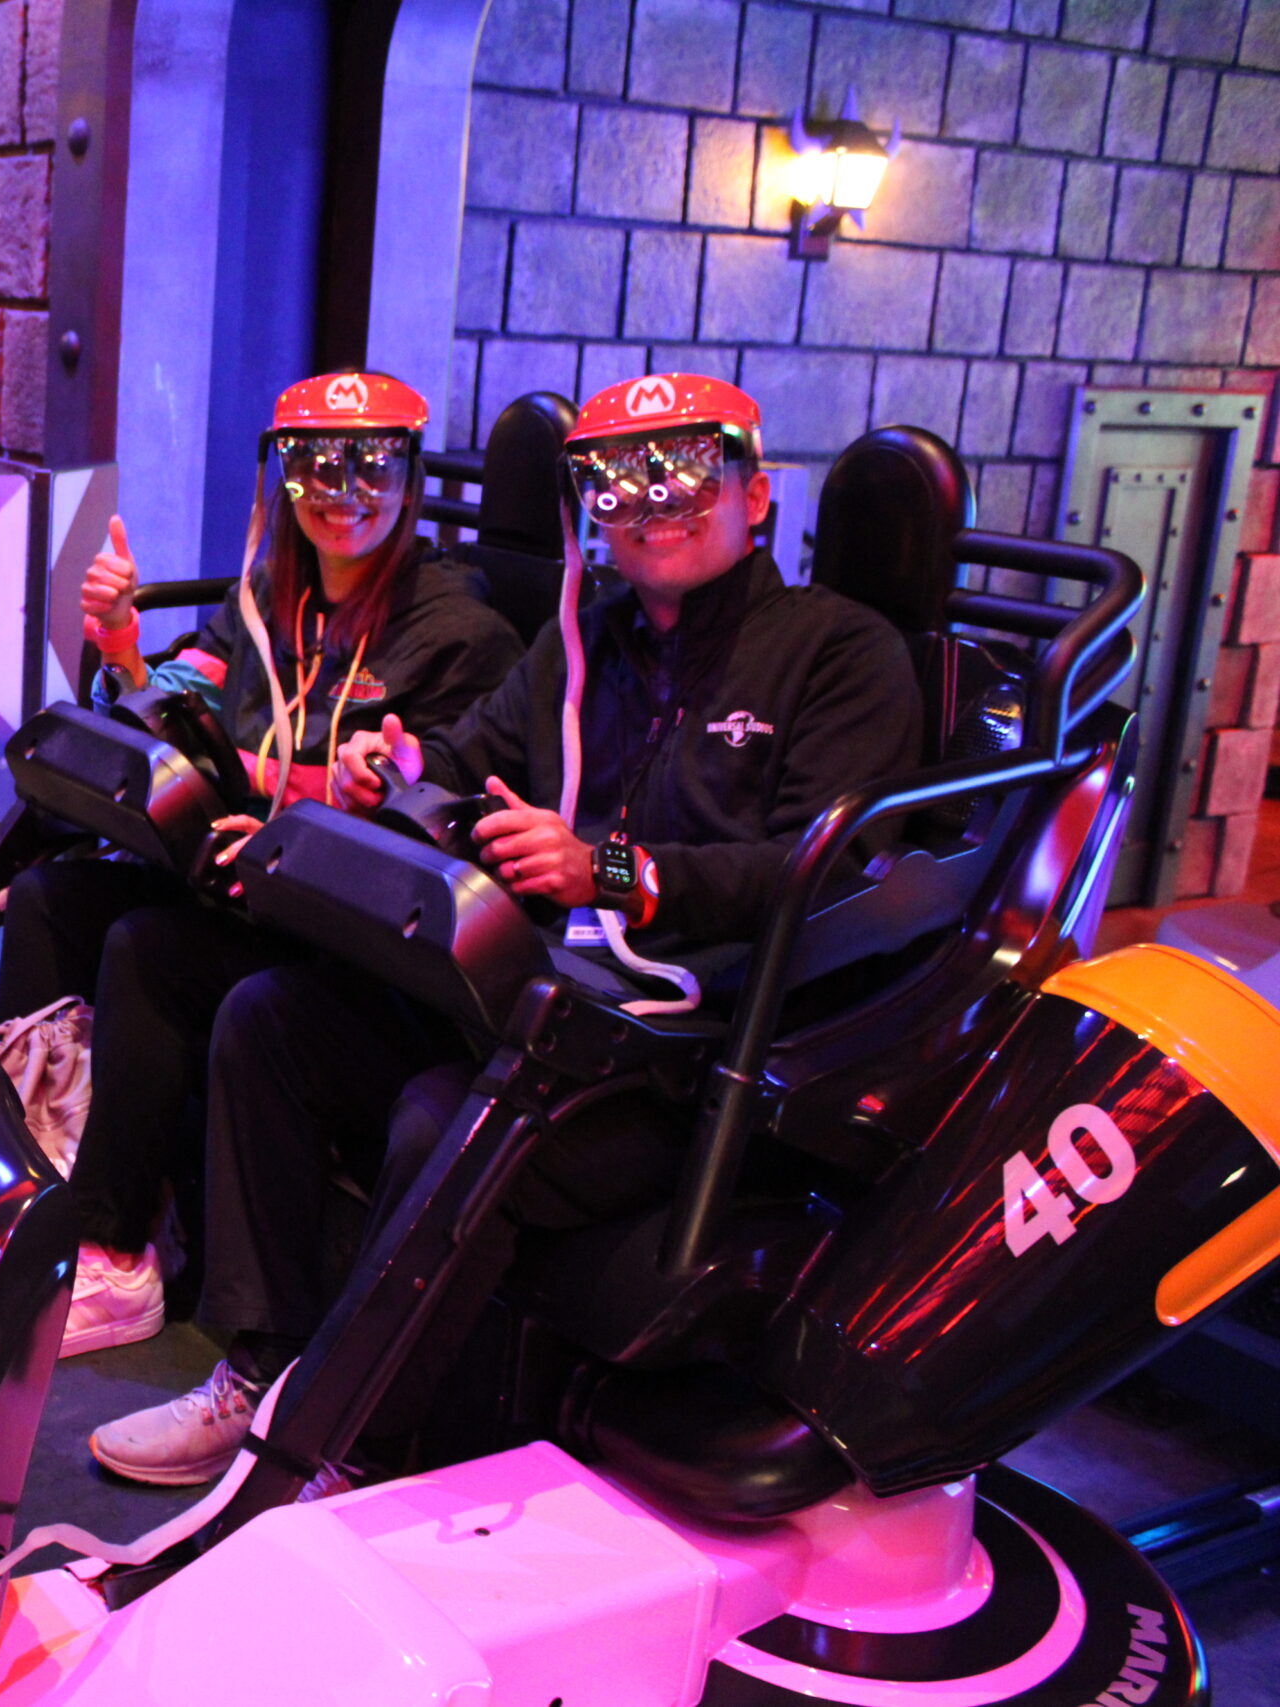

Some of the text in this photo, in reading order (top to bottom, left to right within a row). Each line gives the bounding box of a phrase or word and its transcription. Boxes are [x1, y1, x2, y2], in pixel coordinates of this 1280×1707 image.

[330, 382, 363, 405] M
[631, 383, 670, 412] M
[706, 721, 774, 735] UNIVERSAL STUDIOS
[1003, 1103, 1136, 1258] 40
